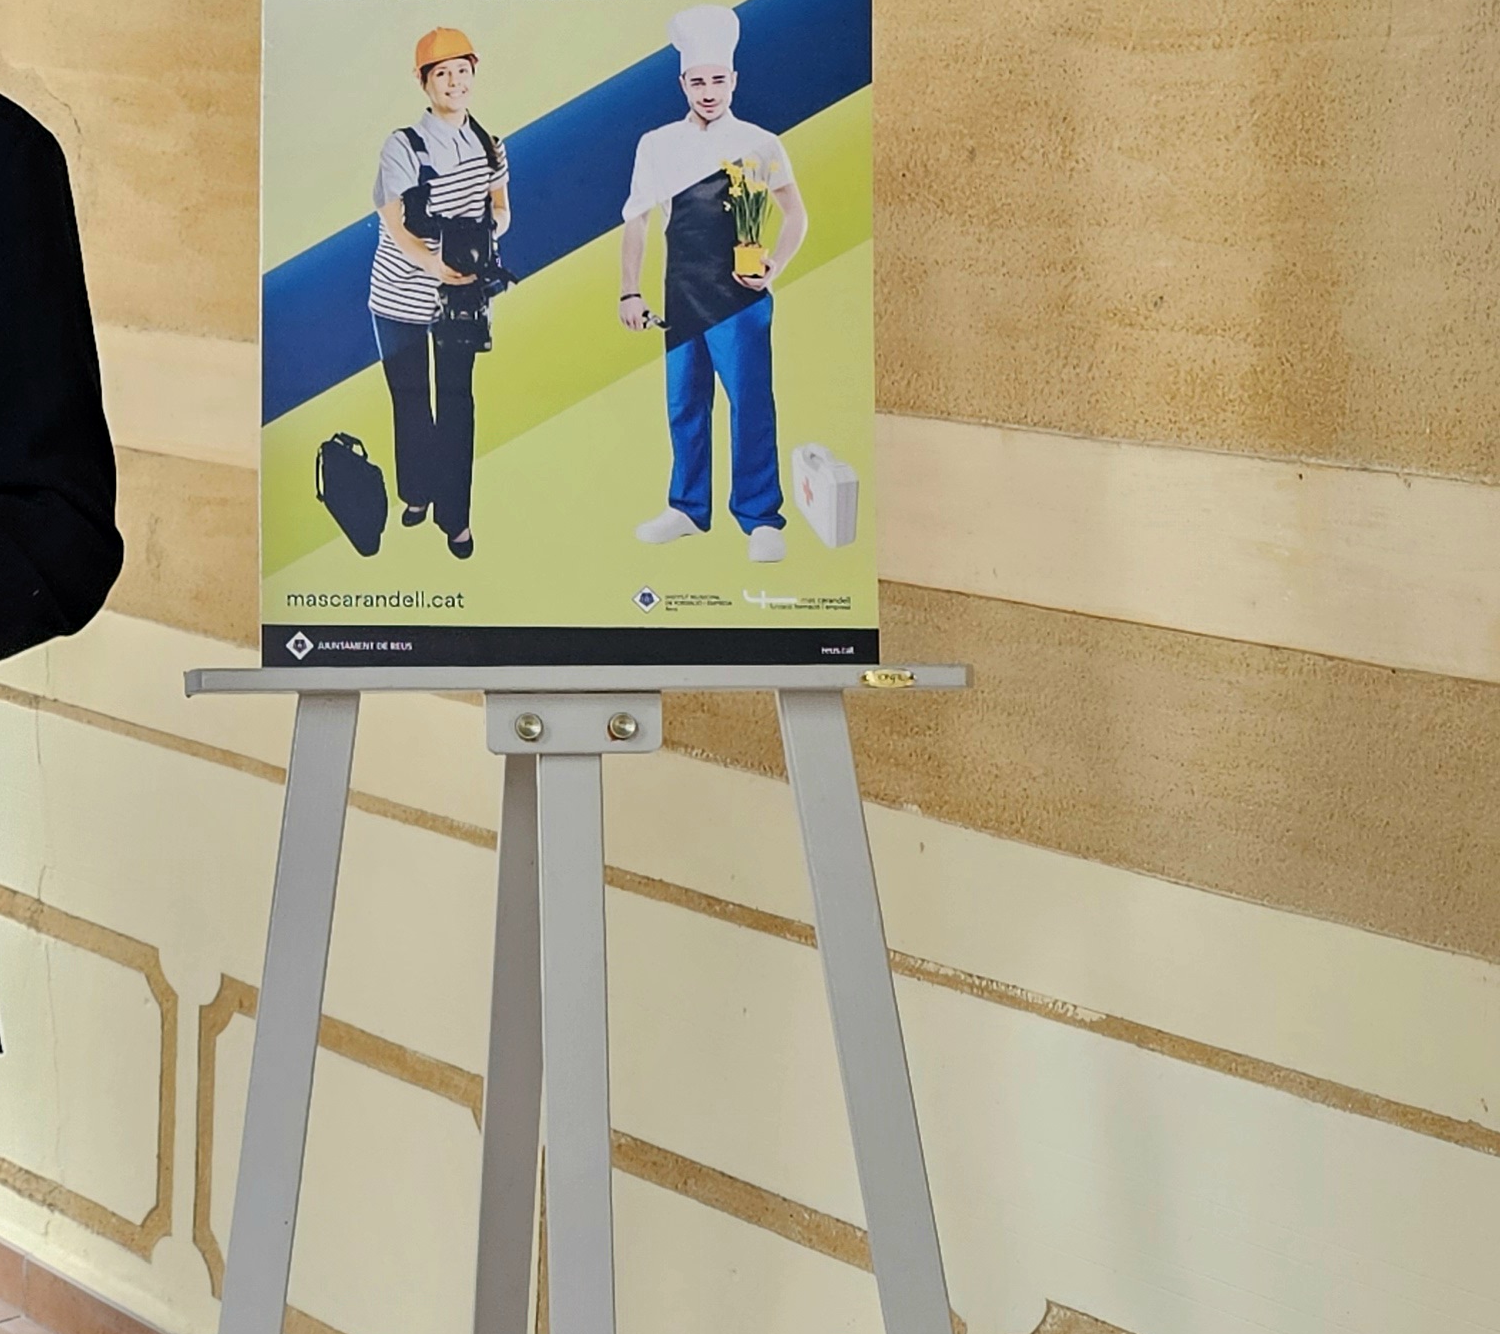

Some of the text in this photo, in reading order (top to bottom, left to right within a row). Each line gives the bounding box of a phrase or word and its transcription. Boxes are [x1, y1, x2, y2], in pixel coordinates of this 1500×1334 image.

[286, 591, 465, 609] mascarandell.cat
[317, 641, 413, 651] AJUNTAMENT DE REUS
